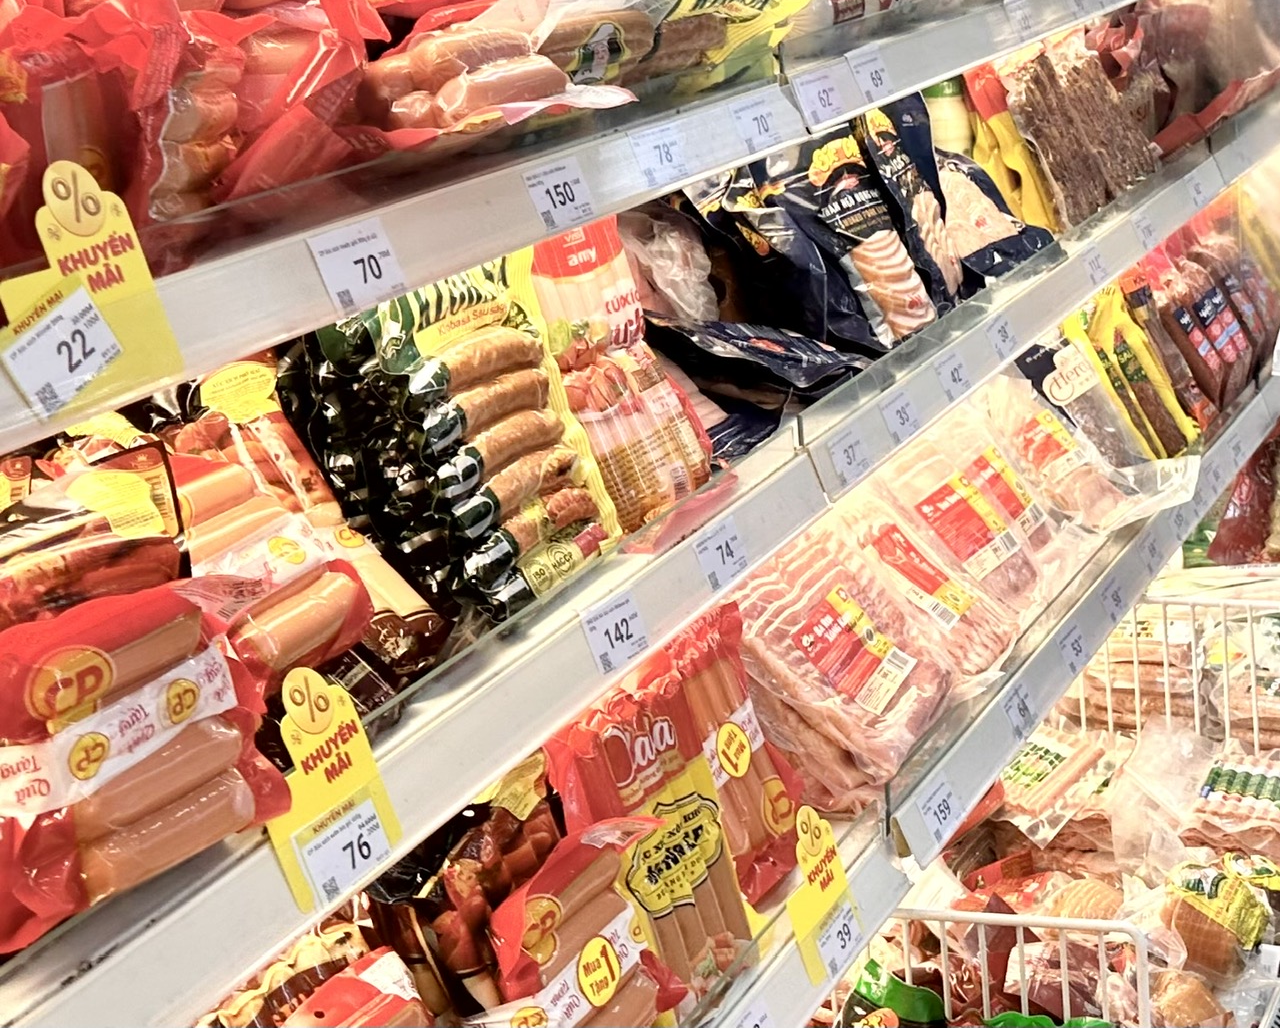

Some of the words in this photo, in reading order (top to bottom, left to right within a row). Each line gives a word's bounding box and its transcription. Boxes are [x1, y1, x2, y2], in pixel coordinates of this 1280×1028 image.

[870, 70, 884, 88] 69
[817, 89, 833, 108] 62
[752, 114, 770, 135] 70
[653, 143, 673, 165] 78
[545, 181, 575, 209] 150
[57, 231, 135, 277] KHUYẾN
[567, 246, 597, 267] amy
[87, 263, 125, 293] MÃI
[353, 254, 382, 284] 70
[13, 304, 48, 336] KHUYẾN
[56, 329, 95, 373] 22
[950, 367, 961, 385] 42
[843, 444, 857, 466] 37
[551, 550, 574, 570] HACCP
[716, 539, 735, 565] 74
[531, 566, 546, 581] ISO
[604, 618, 634, 649] 142
[1071, 640, 1082, 658] 53
[43, 664, 105, 715] CP
[172, 685, 198, 716] CP
[76, 743, 107, 774] CP
[300, 718, 359, 776] KHUYẾN
[324, 750, 354, 784] MÃI
[14, 778, 51, 805] Quà
[933, 799, 952, 825] 159
[342, 832, 372, 869] 76
[807, 844, 838, 886] KHUYẾN
[819, 874, 835, 892] MÃI
[836, 922, 852, 949] 39
[582, 956, 602, 977] Mua
[600, 944, 616, 982] 1
[589, 975, 611, 999] Tặng
